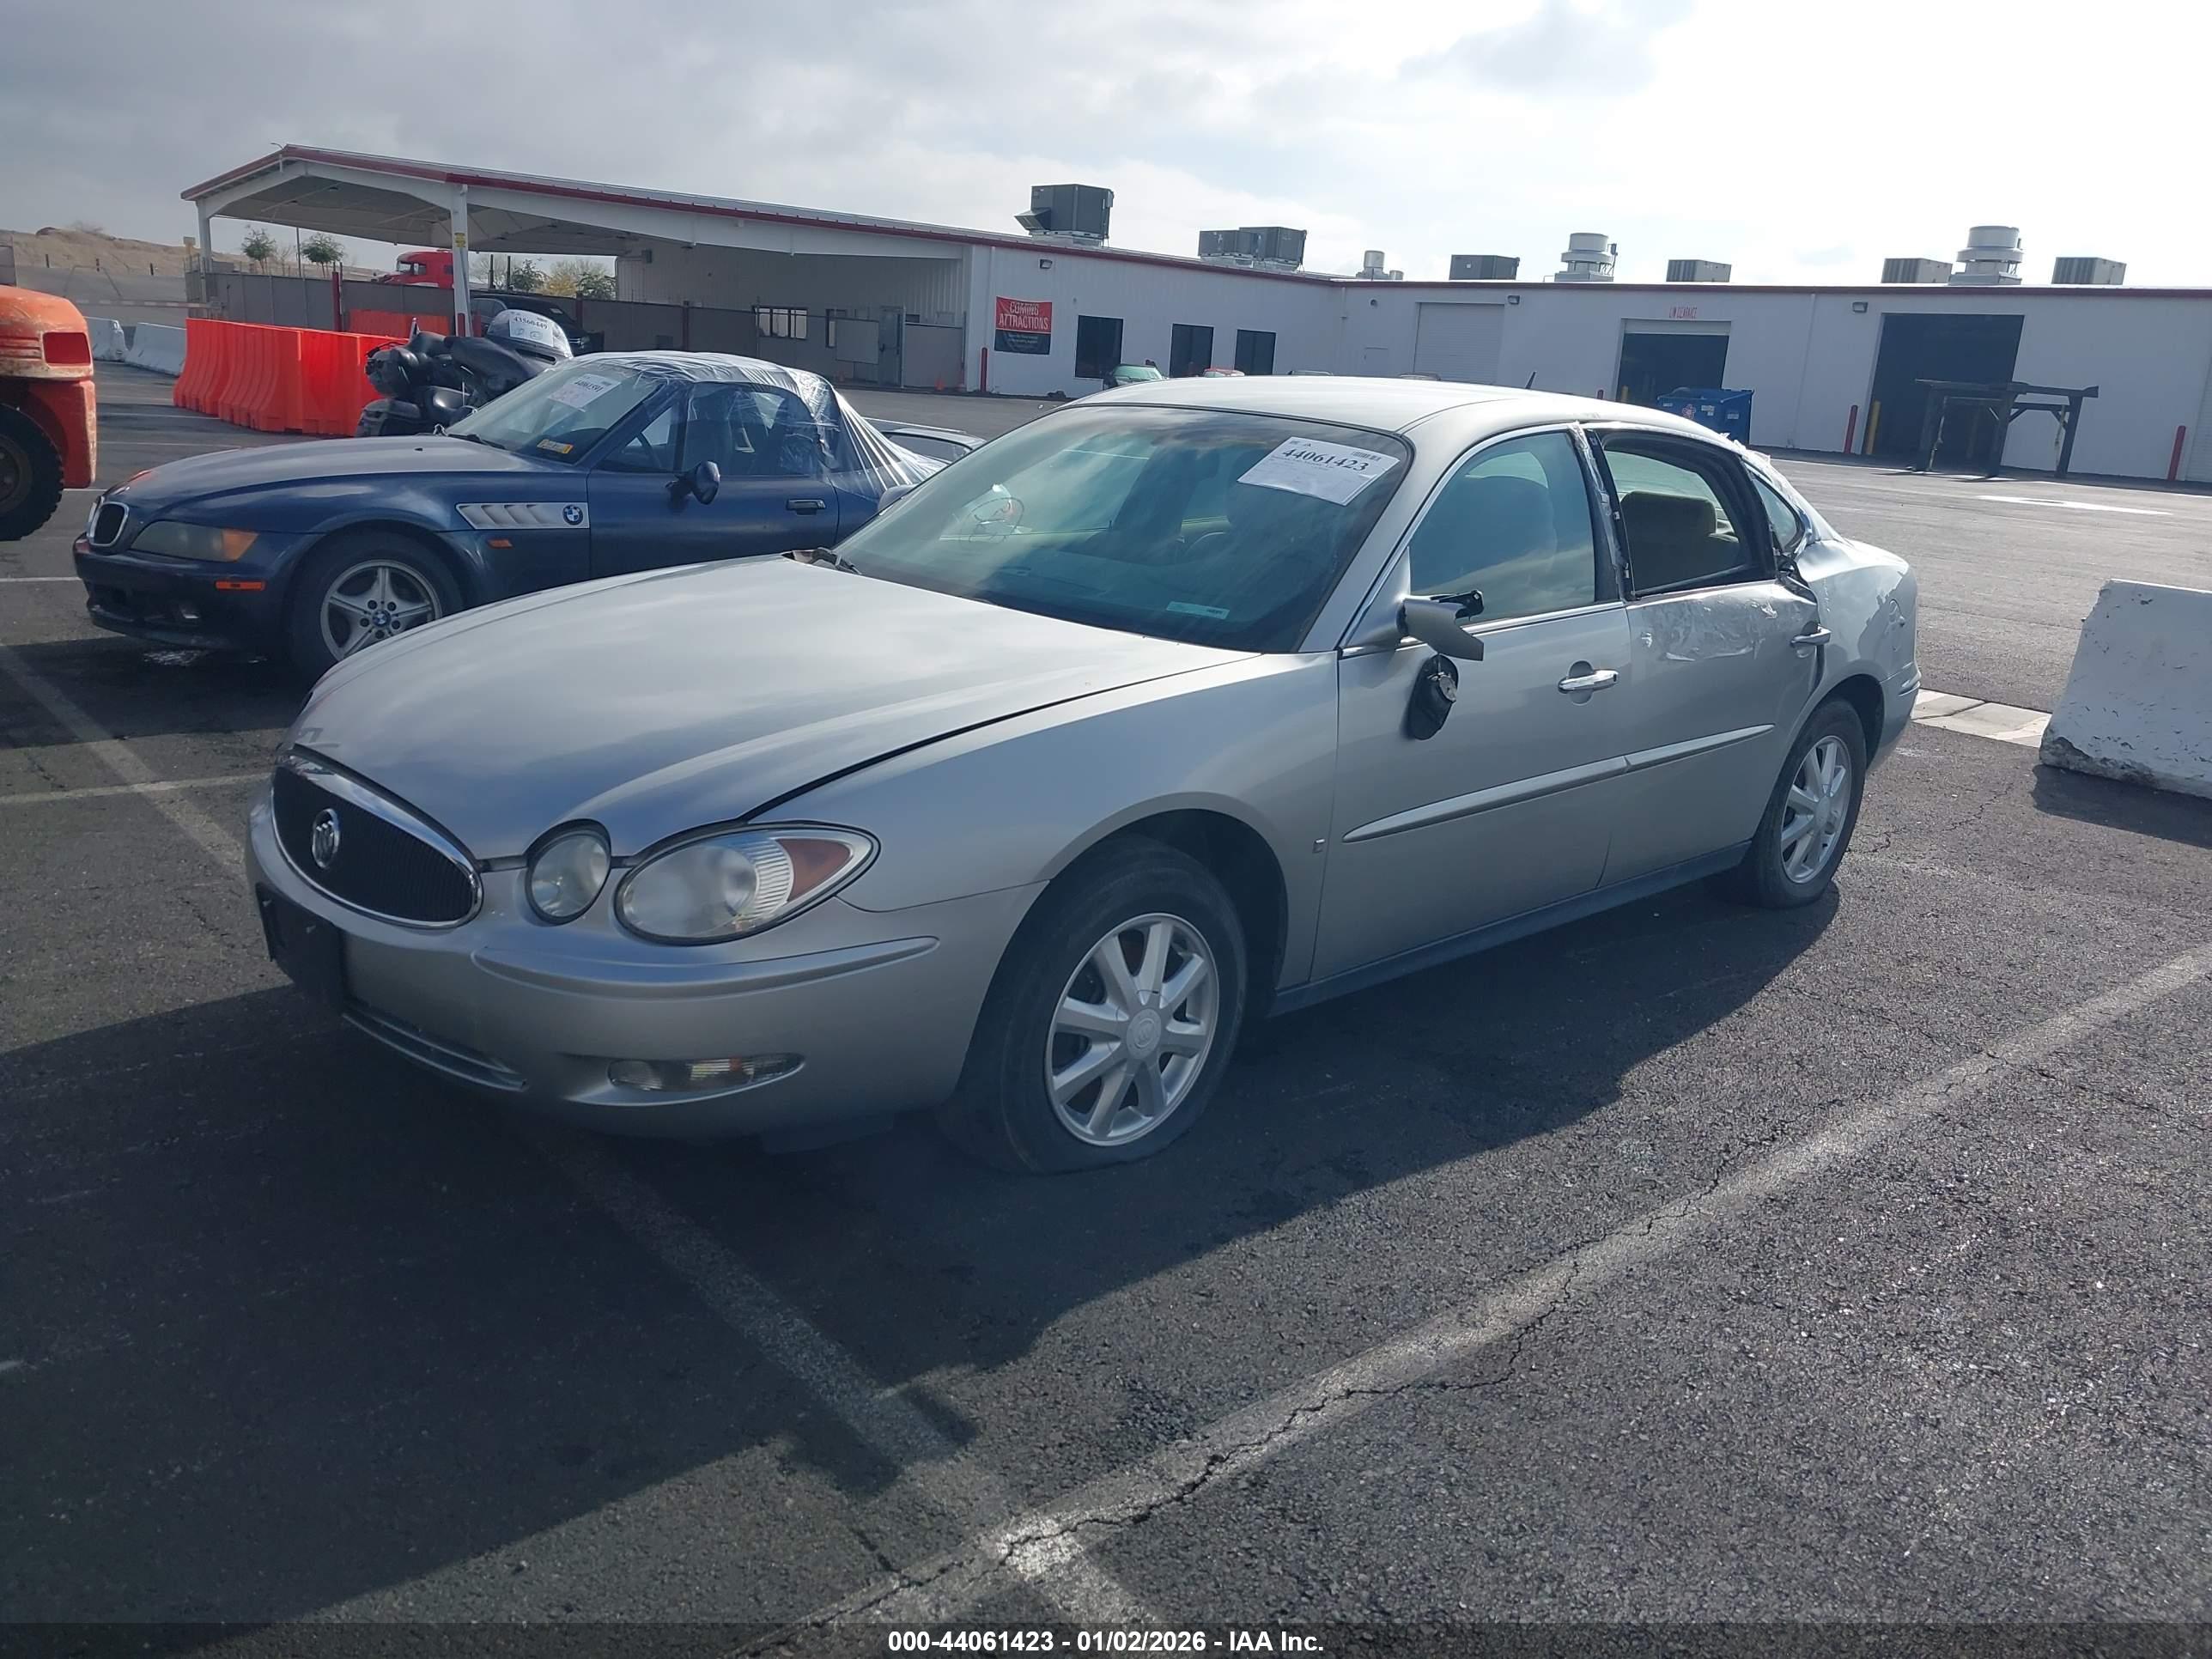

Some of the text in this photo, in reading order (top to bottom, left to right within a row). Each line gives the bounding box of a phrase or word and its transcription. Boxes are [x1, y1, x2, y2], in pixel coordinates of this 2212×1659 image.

[1009, 301, 1040, 316] COMING
[999, 313, 1048, 330] ATTRACTIONS
[1282, 448, 1370, 471] 44061423
